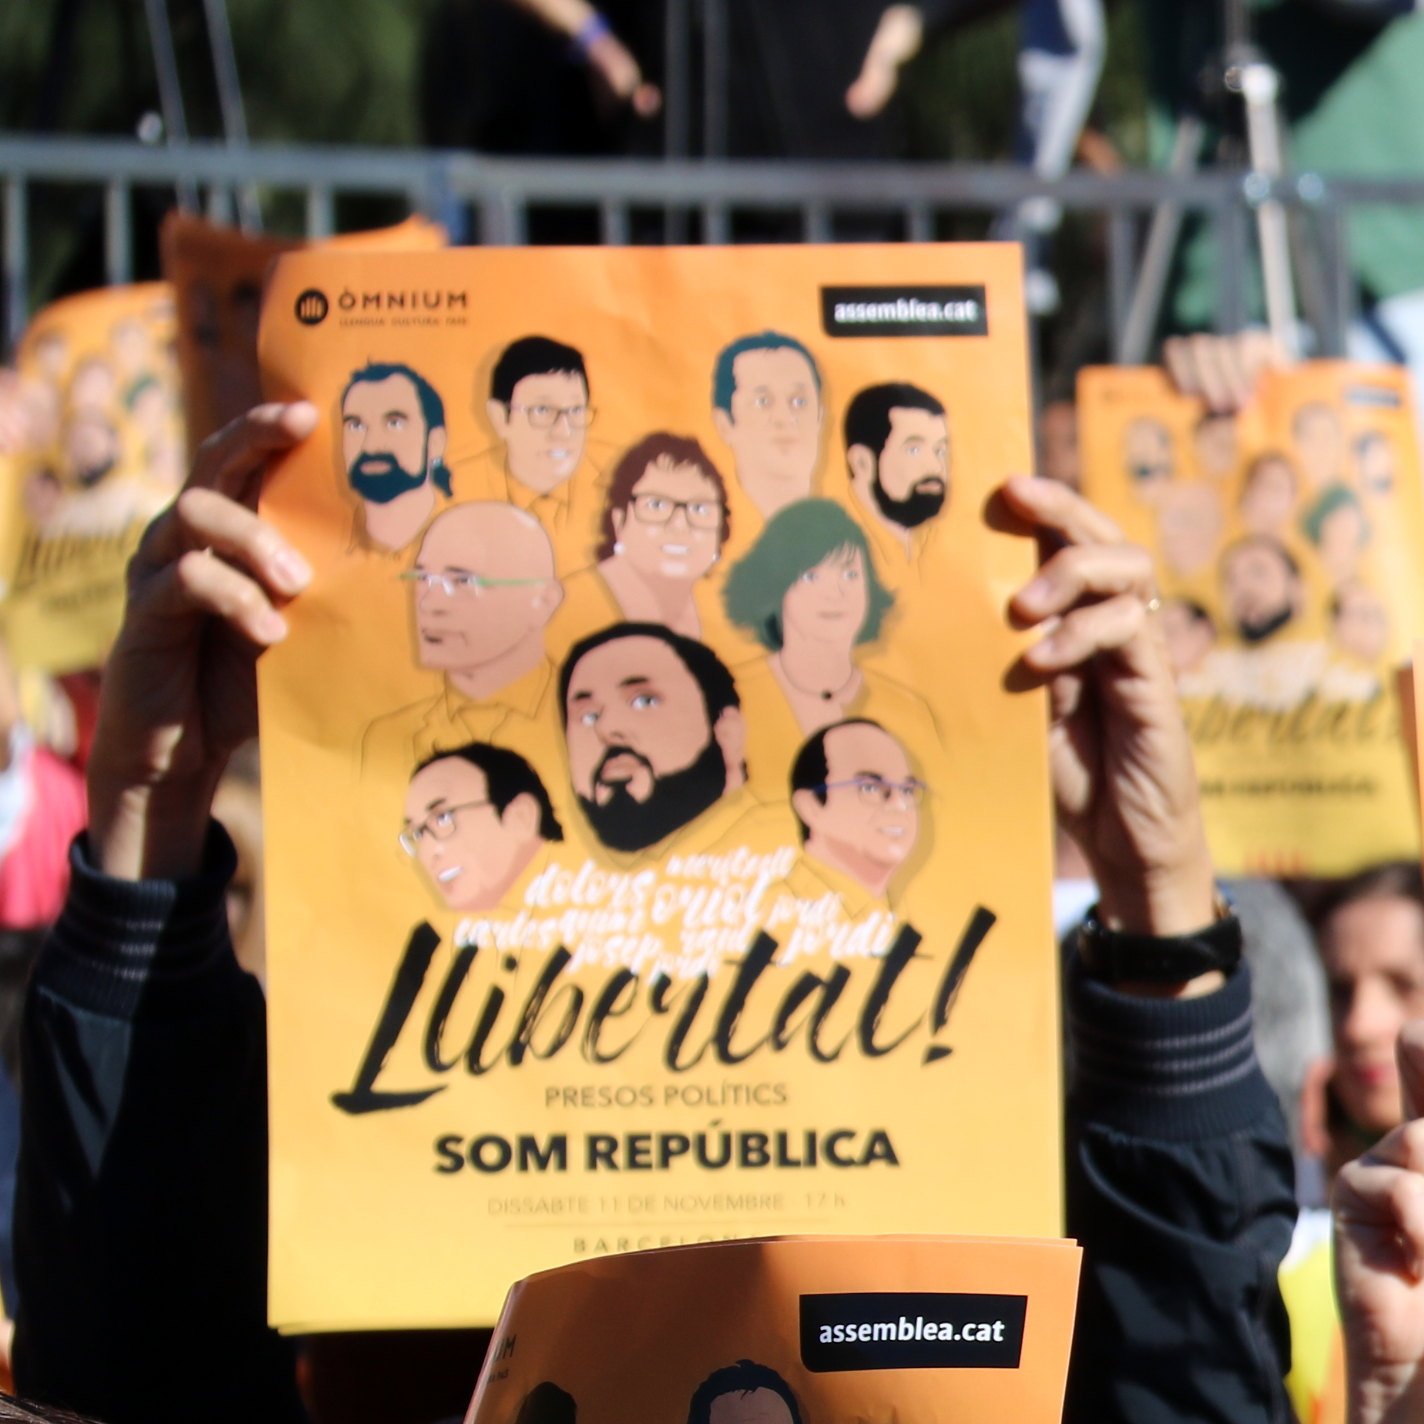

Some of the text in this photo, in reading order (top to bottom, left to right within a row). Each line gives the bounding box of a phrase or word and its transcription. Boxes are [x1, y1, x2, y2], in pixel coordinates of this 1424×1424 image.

[338, 287, 467, 310] ÒMNIUM
[834, 298, 978, 323] assemblea.cat
[327, 904, 998, 1116] Llibertat!
[544, 1078, 788, 1110] PRESOS POLÍTICS
[433, 1120, 900, 1176] SOM REPÚBLICA
[487, 1195, 589, 1216] DISSABTE
[598, 1195, 622, 1214] 11
[627, 1195, 659, 1214] DE
[664, 1193, 784, 1213] NOVEMBRE
[804, 1193, 829, 1211] 17
[819, 1317, 1005, 1343] assemblea.cat
